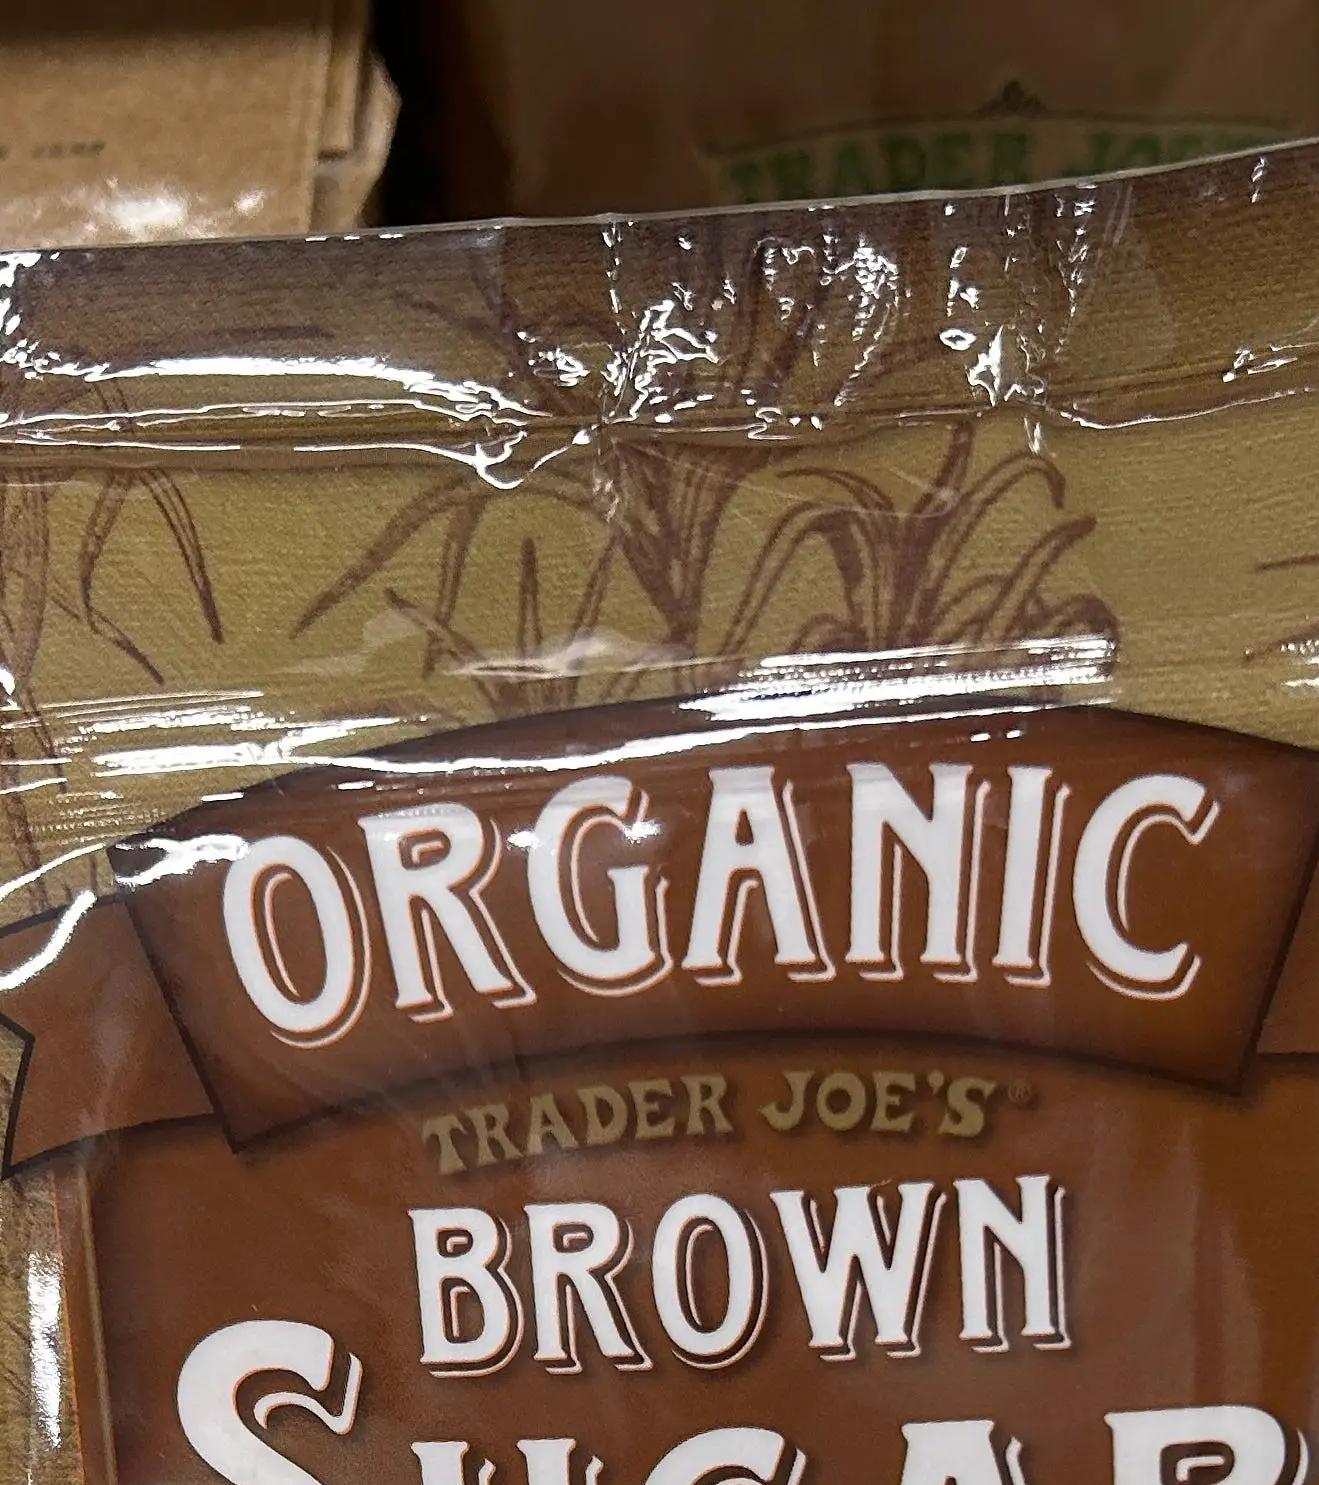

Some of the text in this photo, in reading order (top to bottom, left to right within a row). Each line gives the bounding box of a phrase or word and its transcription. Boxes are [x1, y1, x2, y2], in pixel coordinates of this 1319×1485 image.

[220, 762, 1220, 1048] ORGANIC
[423, 1068, 1000, 1173] TRADER JOE'S
[407, 1174, 1070, 1377] BROWN
